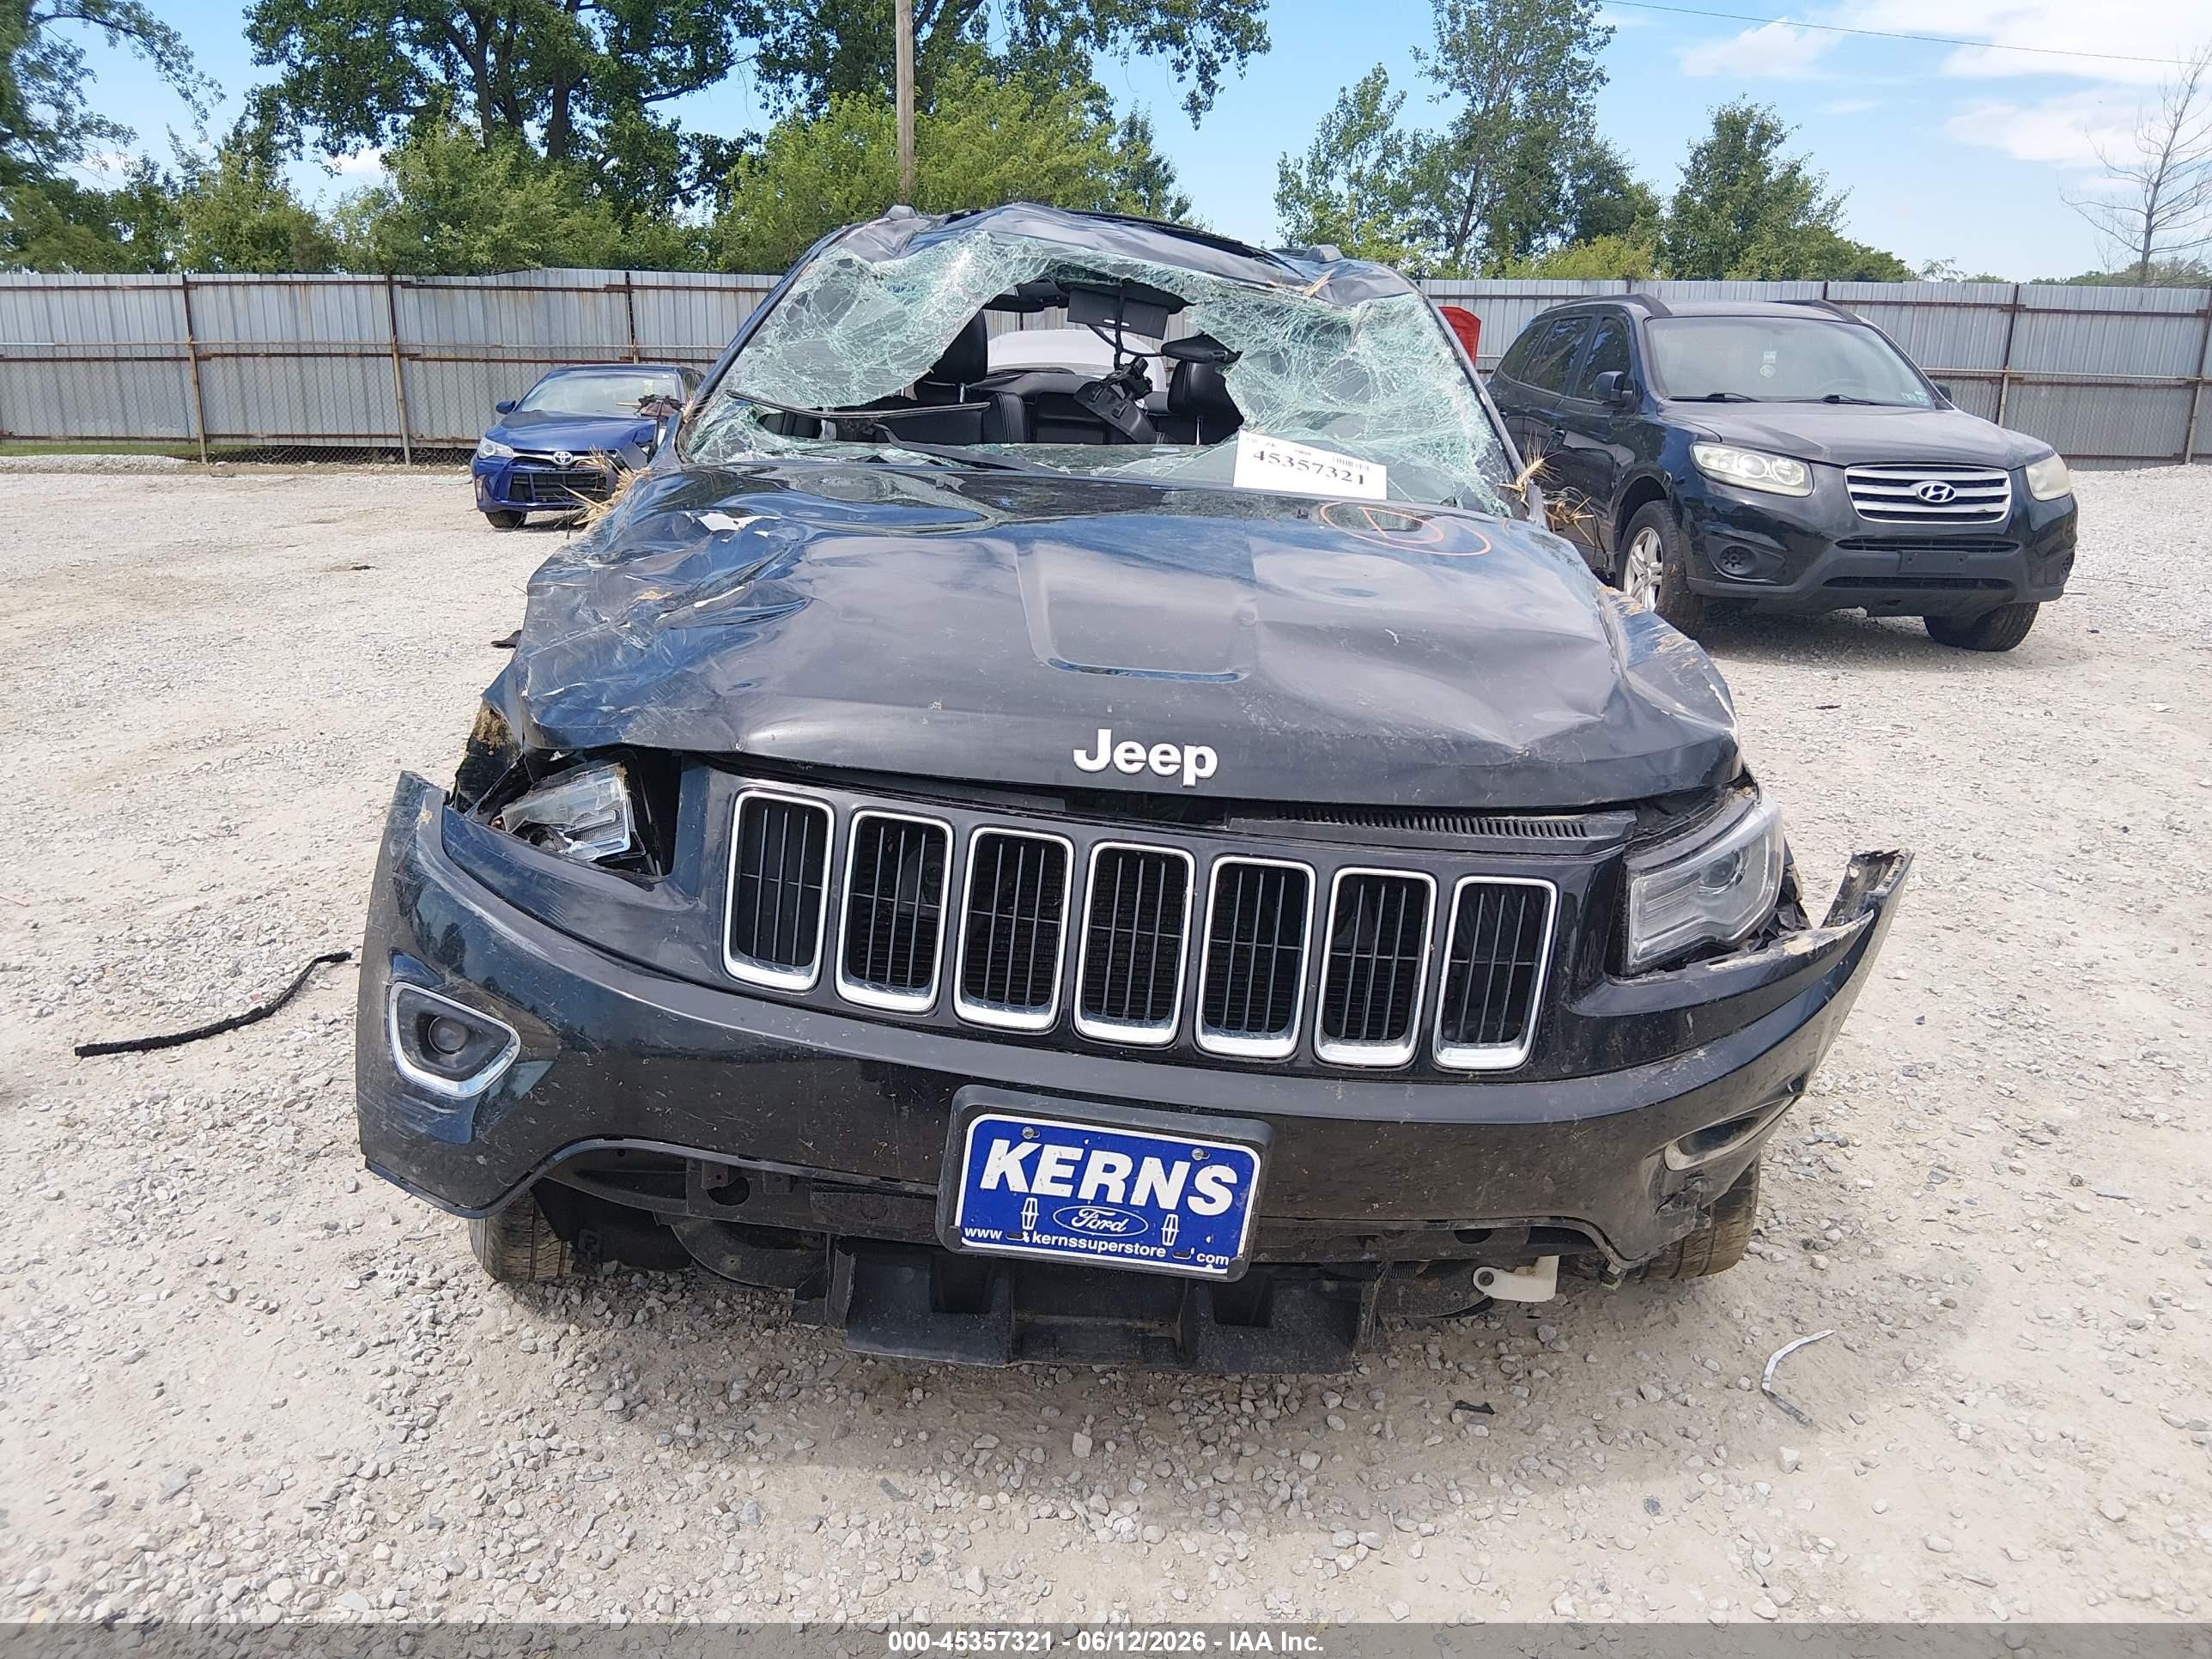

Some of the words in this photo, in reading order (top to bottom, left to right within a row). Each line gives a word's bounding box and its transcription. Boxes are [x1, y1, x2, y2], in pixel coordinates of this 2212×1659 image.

[1253, 451, 1364, 485] 45357321
[1073, 729, 1218, 787] Jeep
[980, 1139, 1238, 1216] KERNS
[1071, 1207, 1130, 1232] Ford
[1032, 1231, 1166, 1258] kernssuperstore
